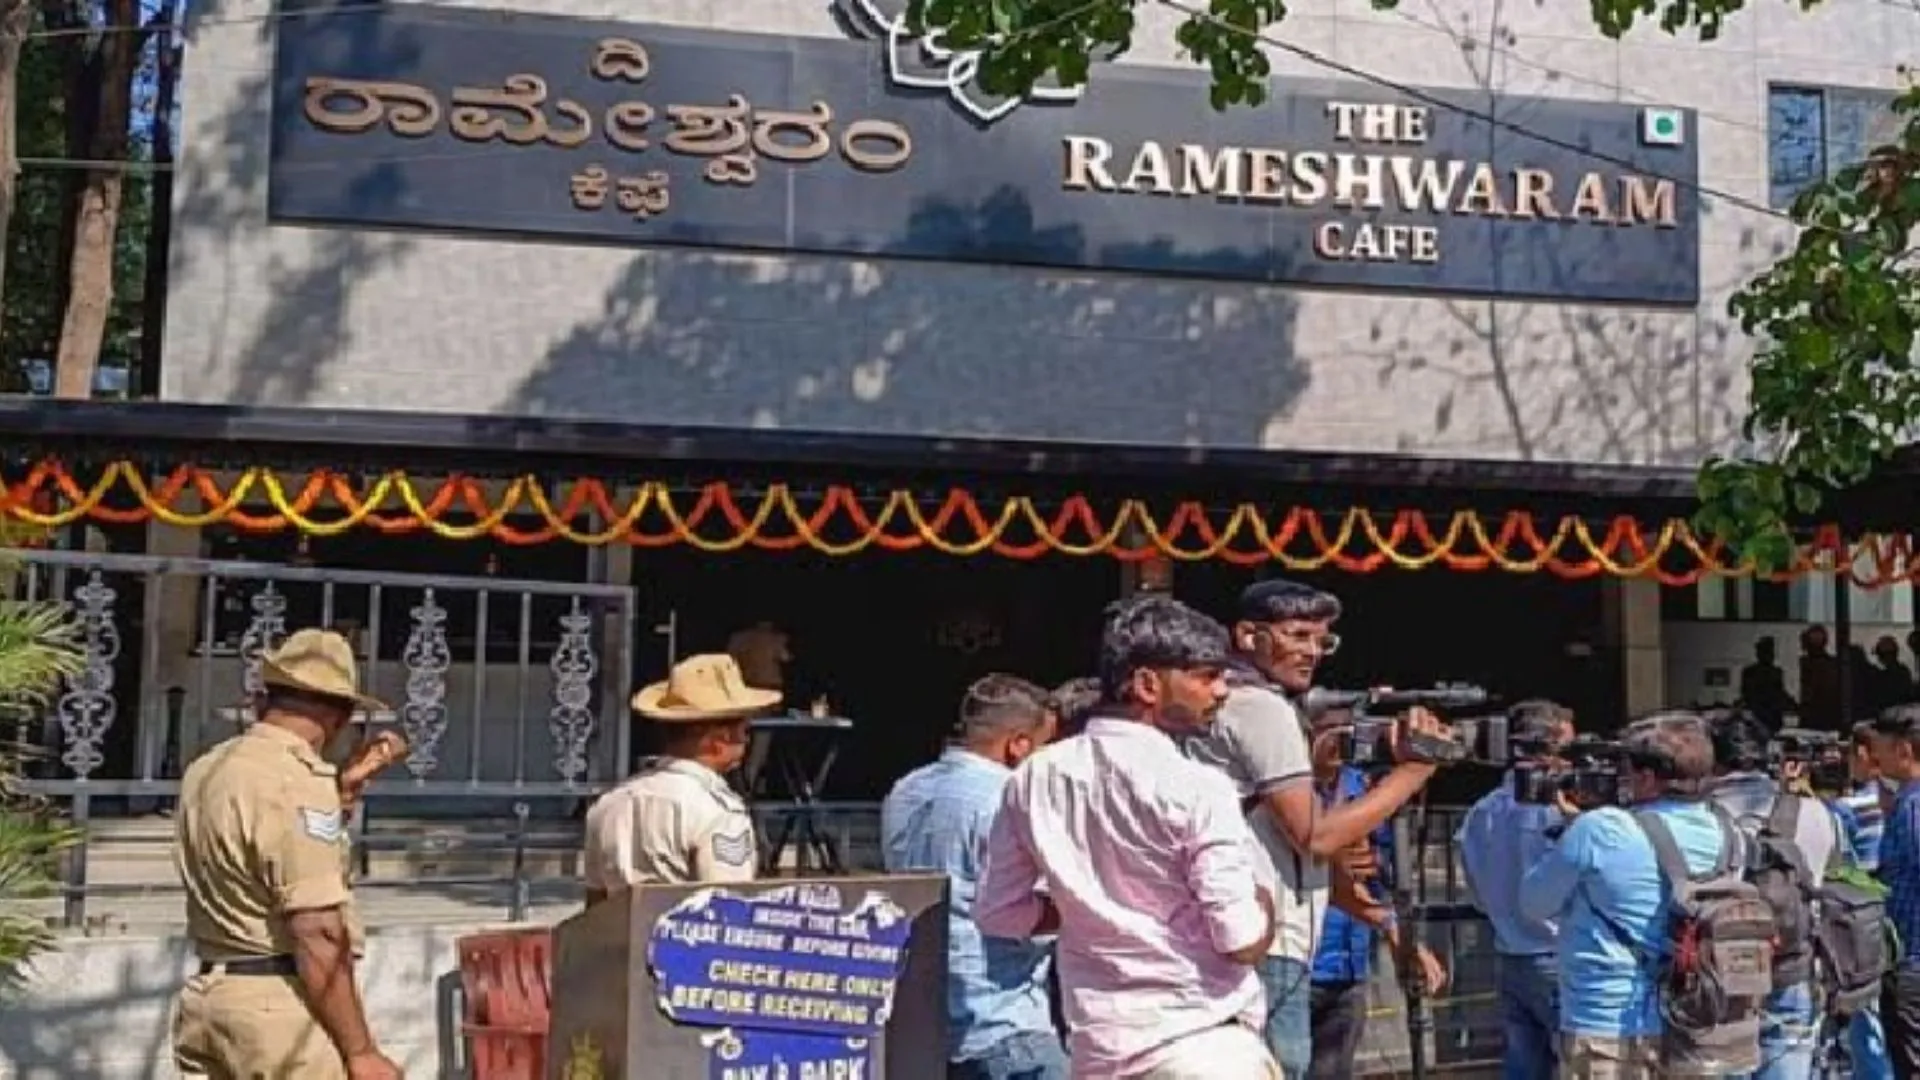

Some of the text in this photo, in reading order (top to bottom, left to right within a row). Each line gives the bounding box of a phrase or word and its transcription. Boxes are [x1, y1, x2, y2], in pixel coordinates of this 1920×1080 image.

[592, 37, 650, 80] ದಿ
[303, 73, 912, 184] ರಾಮೇಶ್ವರಂ
[1327, 102, 1428, 142] THE
[1062, 135, 1677, 228] RAMESHWARAM
[1317, 221, 1438, 262] CAFE
[709, 958, 782, 987] CHECK
[784, 970, 838, 992] HERE
[672, 985, 755, 1012] BEFORE
[760, 993, 868, 1025] RECEIVING
